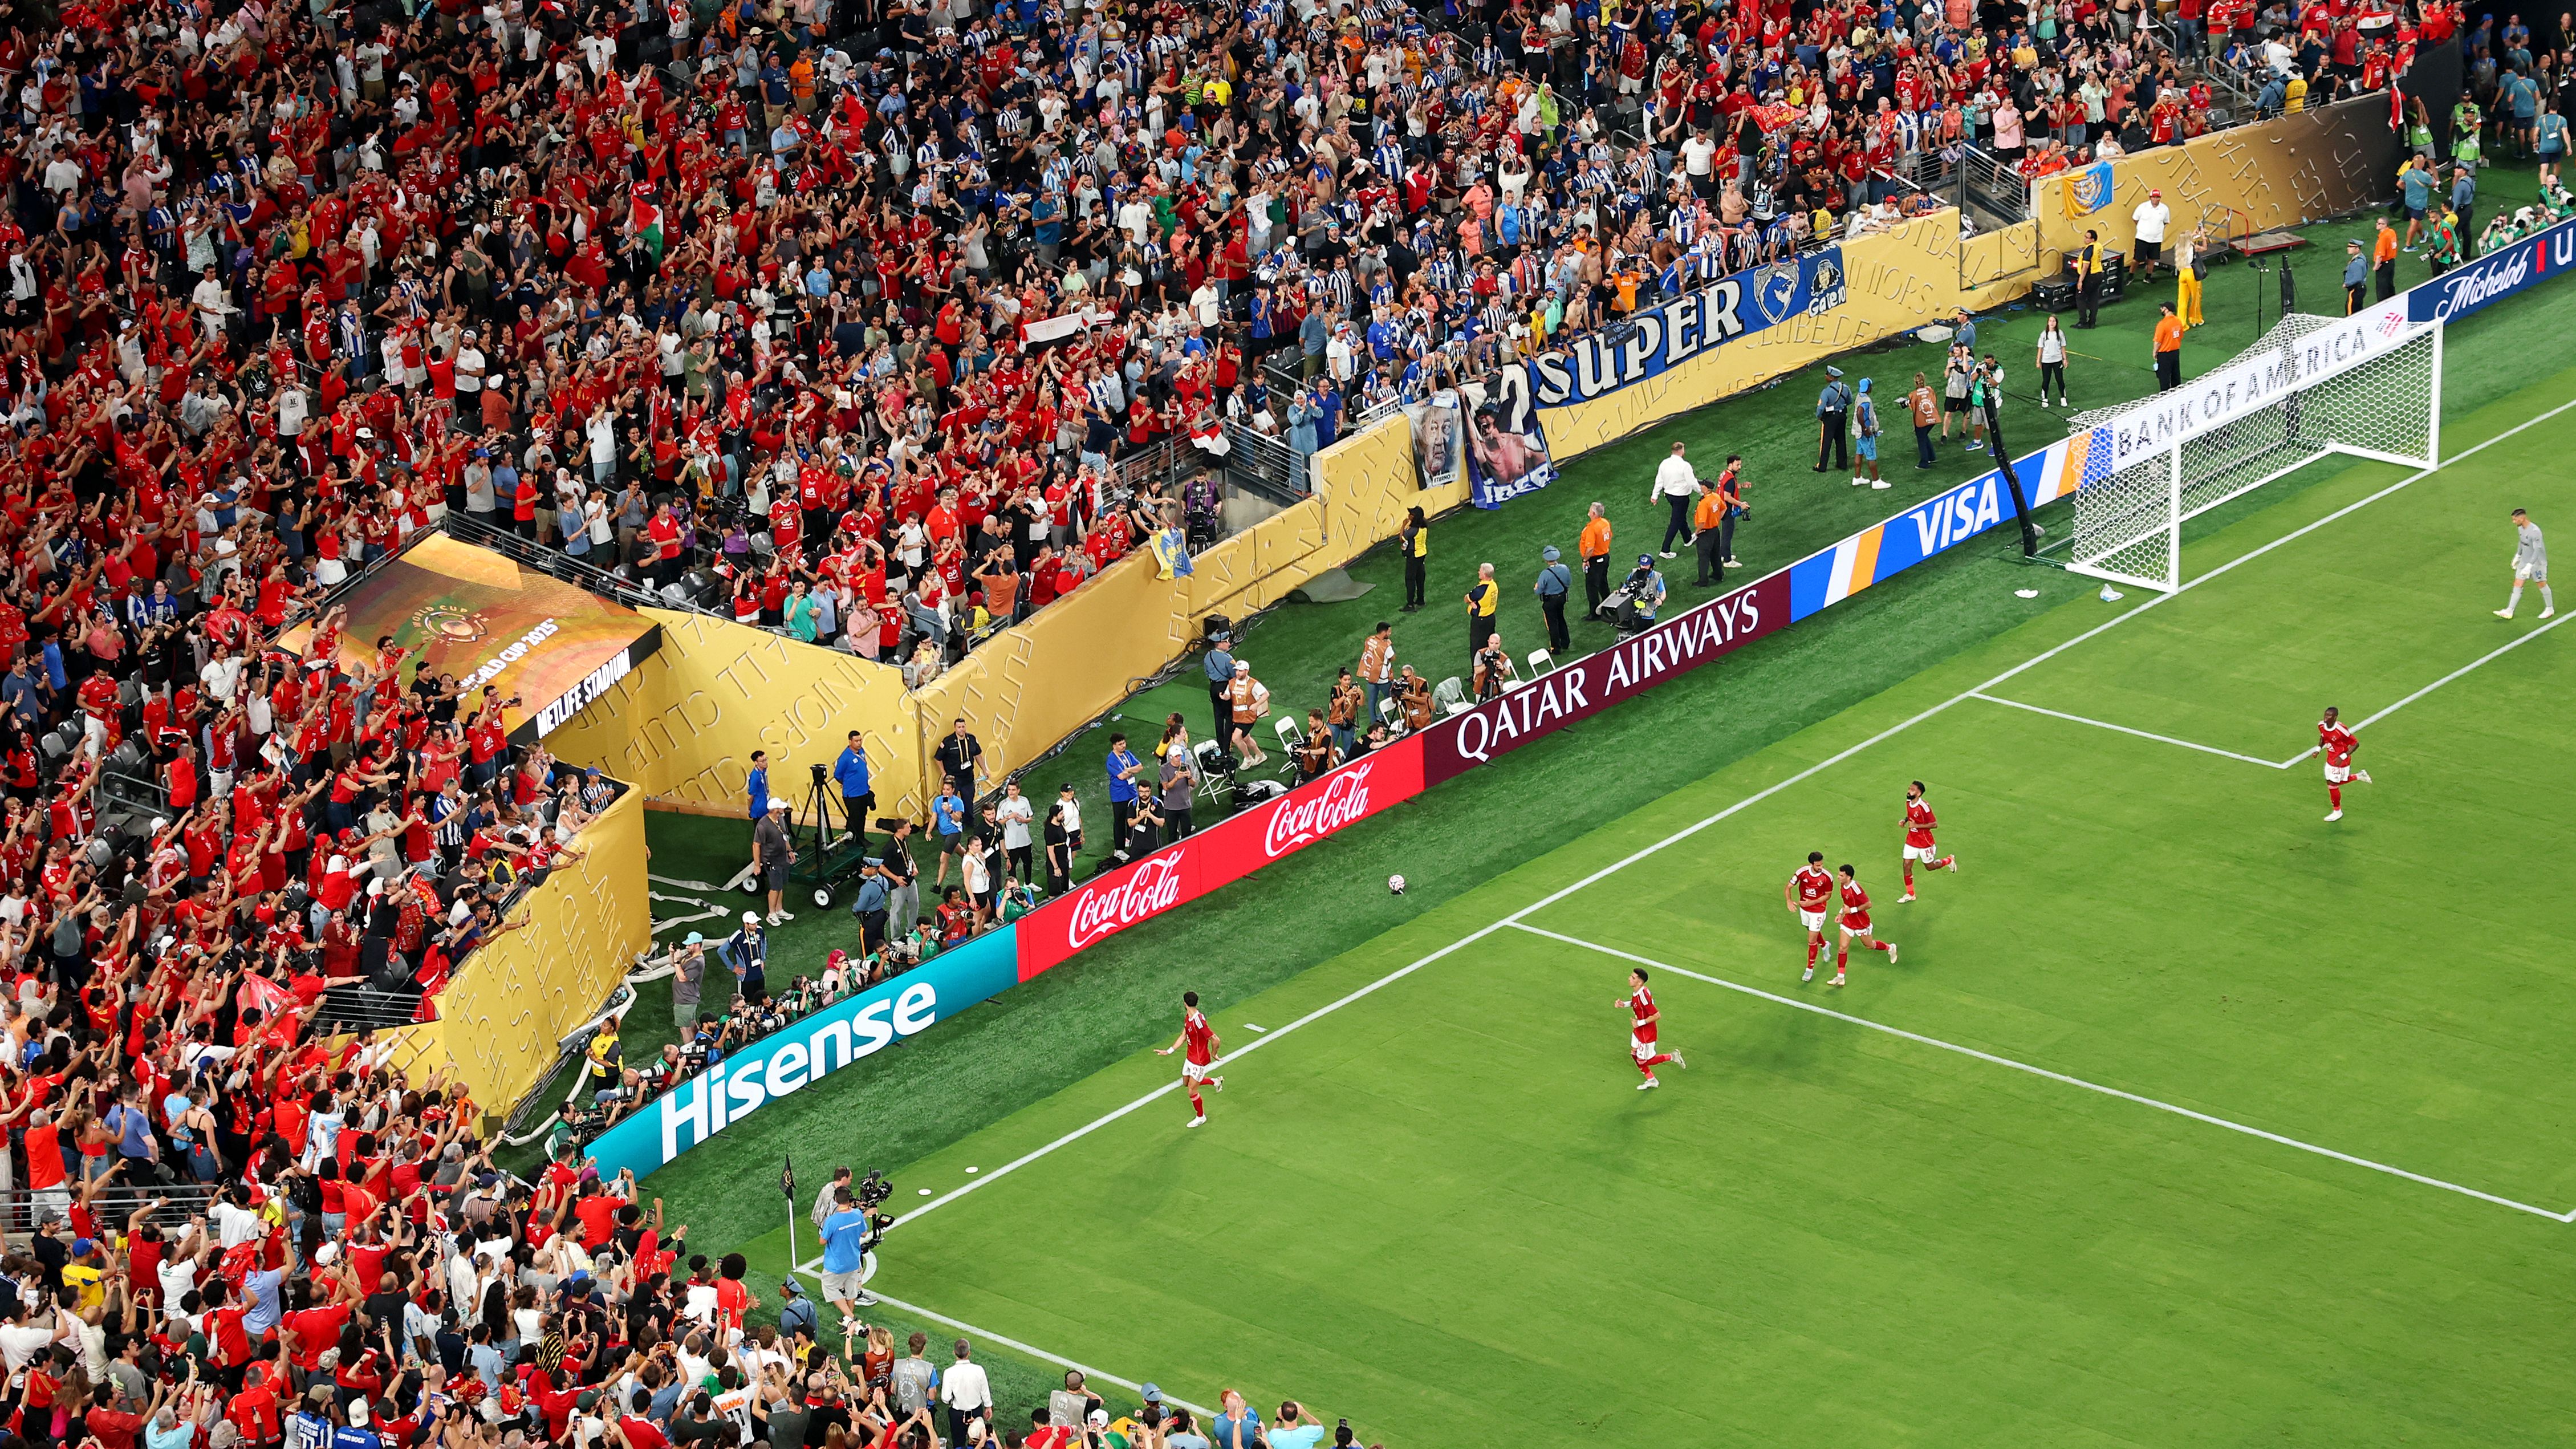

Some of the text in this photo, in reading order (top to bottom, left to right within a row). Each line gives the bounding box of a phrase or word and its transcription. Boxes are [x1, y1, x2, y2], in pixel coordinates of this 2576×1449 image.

[1484, 162, 1493, 172] 23
[2435, 246, 2532, 323] Michelob
[1537, 280, 1742, 404] SUPER
[2118, 326, 2367, 458] BANK OF AMERICA
[1434, 474, 1452, 484] ETERNO
[1908, 477, 2000, 557] VISA
[439, 604, 468, 613] CUP
[499, 642, 529, 662] CUP
[1456, 590, 1759, 762] QATAR AIRWAYS
[537, 681, 584, 739] METLIFE
[583, 647, 631, 703] STADIUM
[1264, 760, 1374, 858] Coca-Cola
[1068, 847, 1185, 949] Coca-Cola
[661, 982, 937, 1165] Hisense
[351, 1435, 366, 1444] BOCK
[720, 1397, 745, 1411] BMG
[727, 1407, 745, 1427] 11
